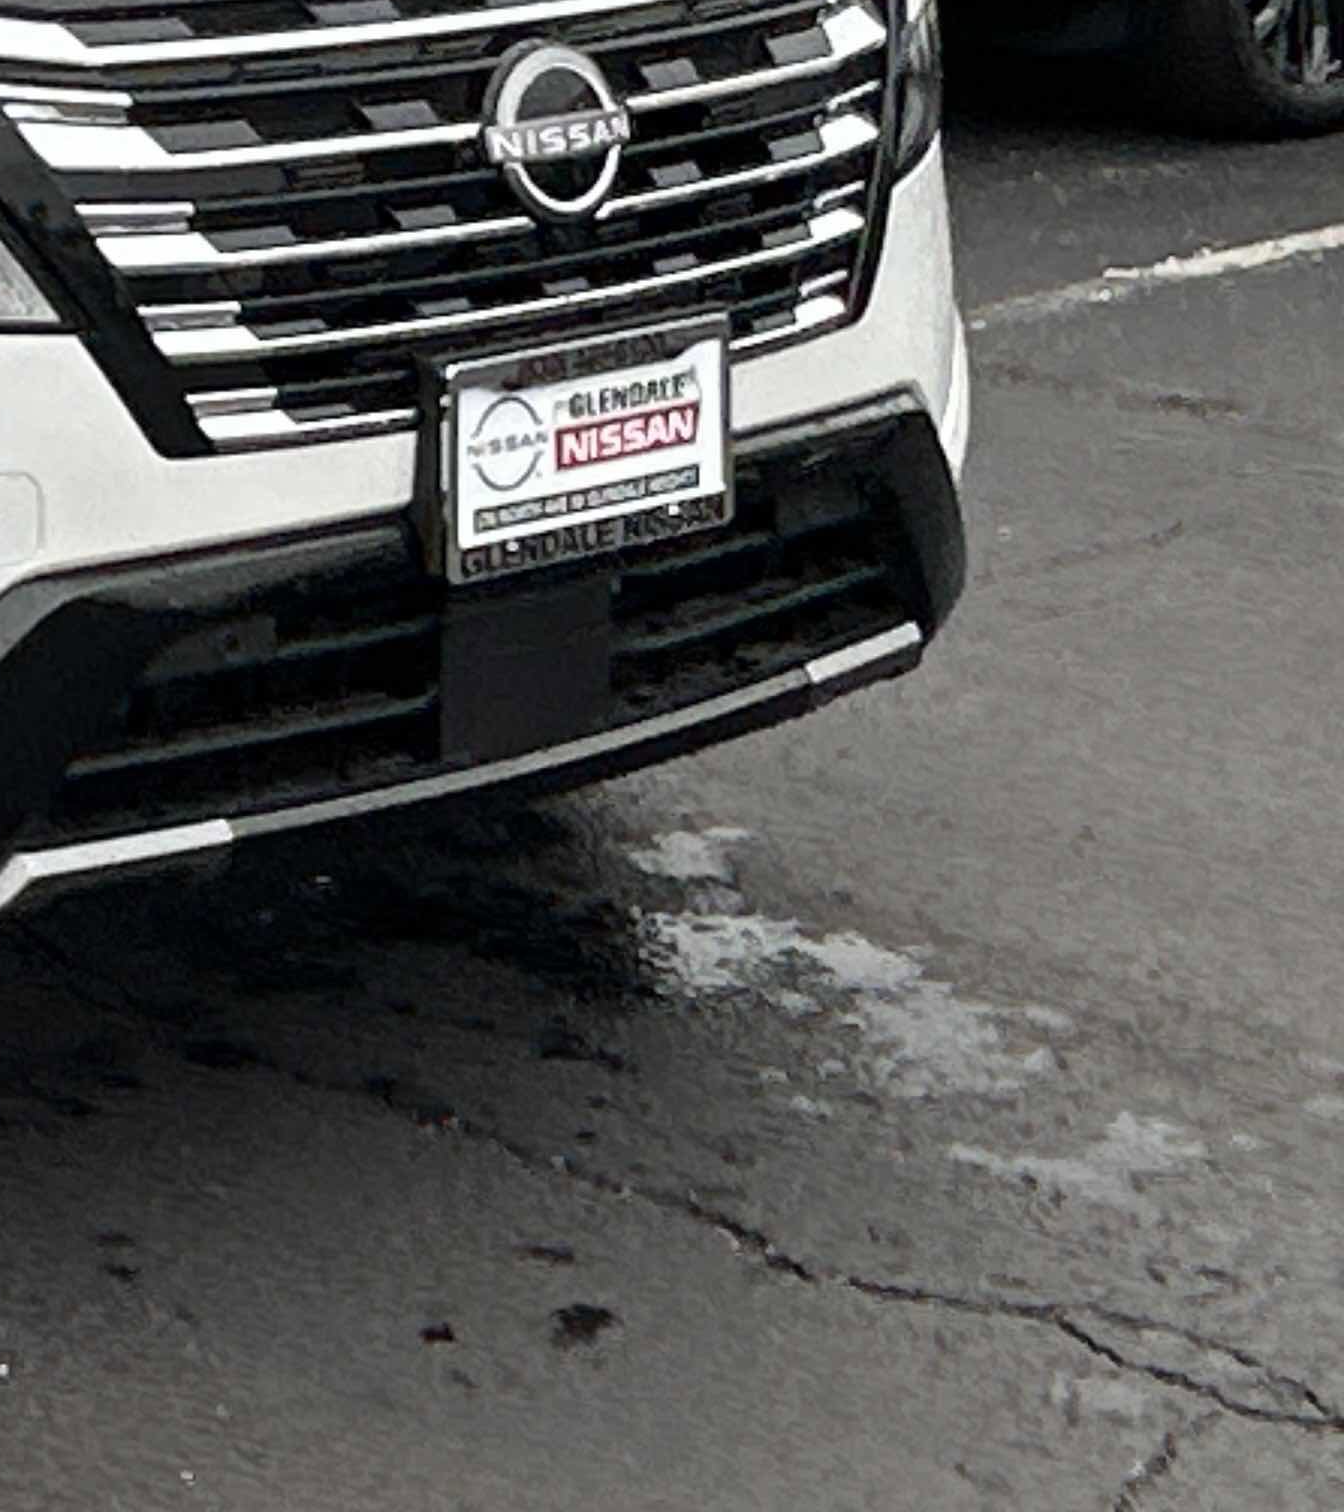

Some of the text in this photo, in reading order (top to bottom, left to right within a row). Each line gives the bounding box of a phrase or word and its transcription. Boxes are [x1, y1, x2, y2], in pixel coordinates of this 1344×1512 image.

[486, 111, 630, 162] NISSAN
[569, 372, 686, 418] GLENDALE
[466, 430, 548, 457] NISSAN
[561, 407, 694, 465] NISSAN
